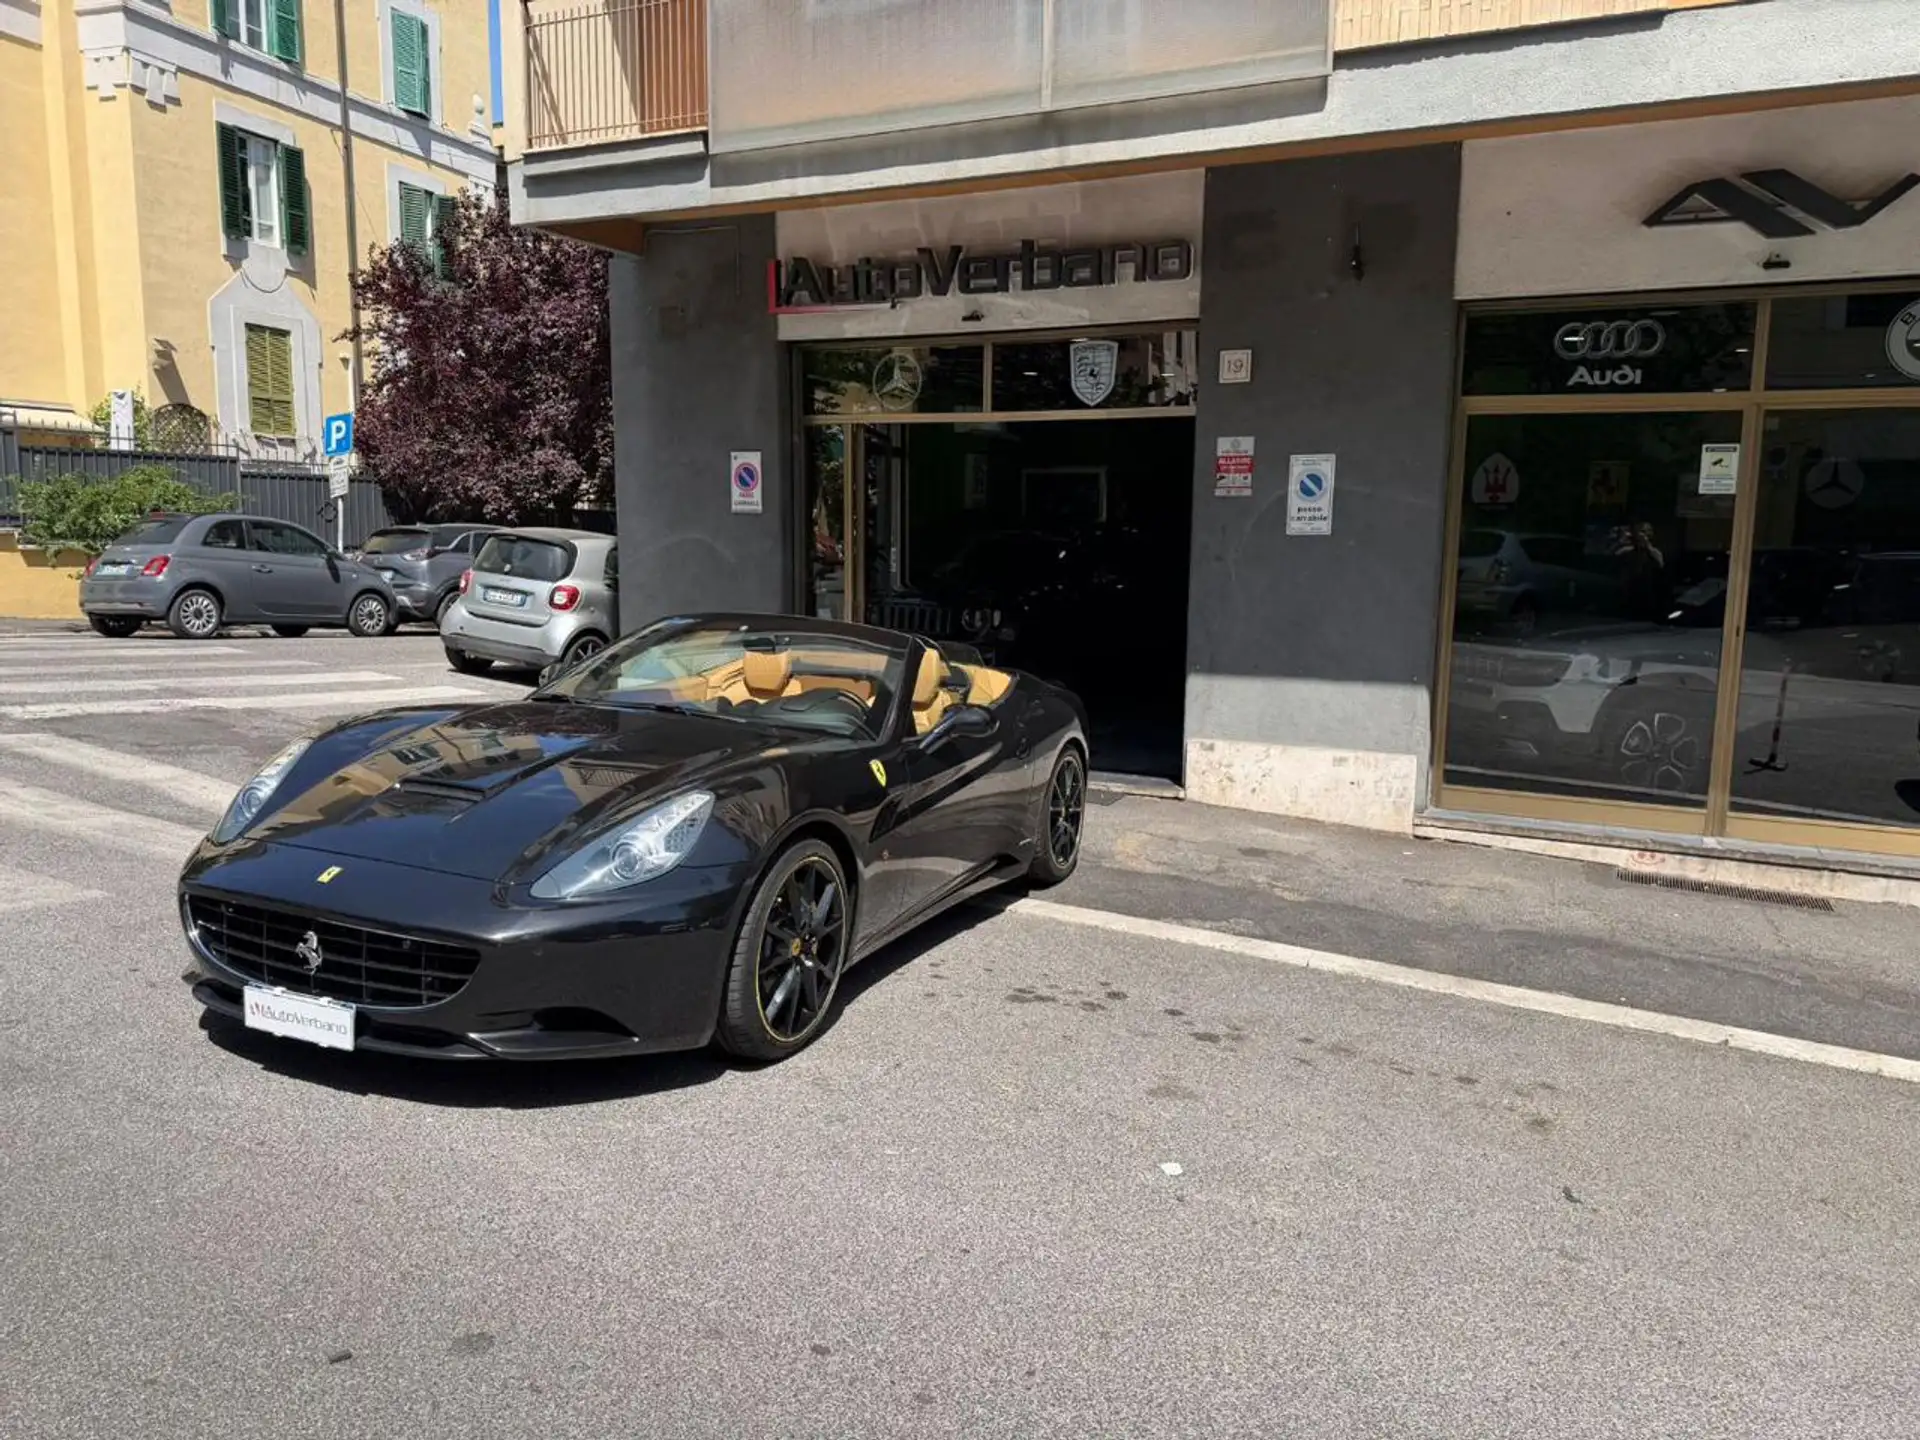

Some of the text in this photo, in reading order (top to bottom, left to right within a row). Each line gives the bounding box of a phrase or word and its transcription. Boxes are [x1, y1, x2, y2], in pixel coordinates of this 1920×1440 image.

[1227, 358, 1244, 373] 19
[1565, 364, 1642, 386] Audi
[328, 420, 347, 451] P
